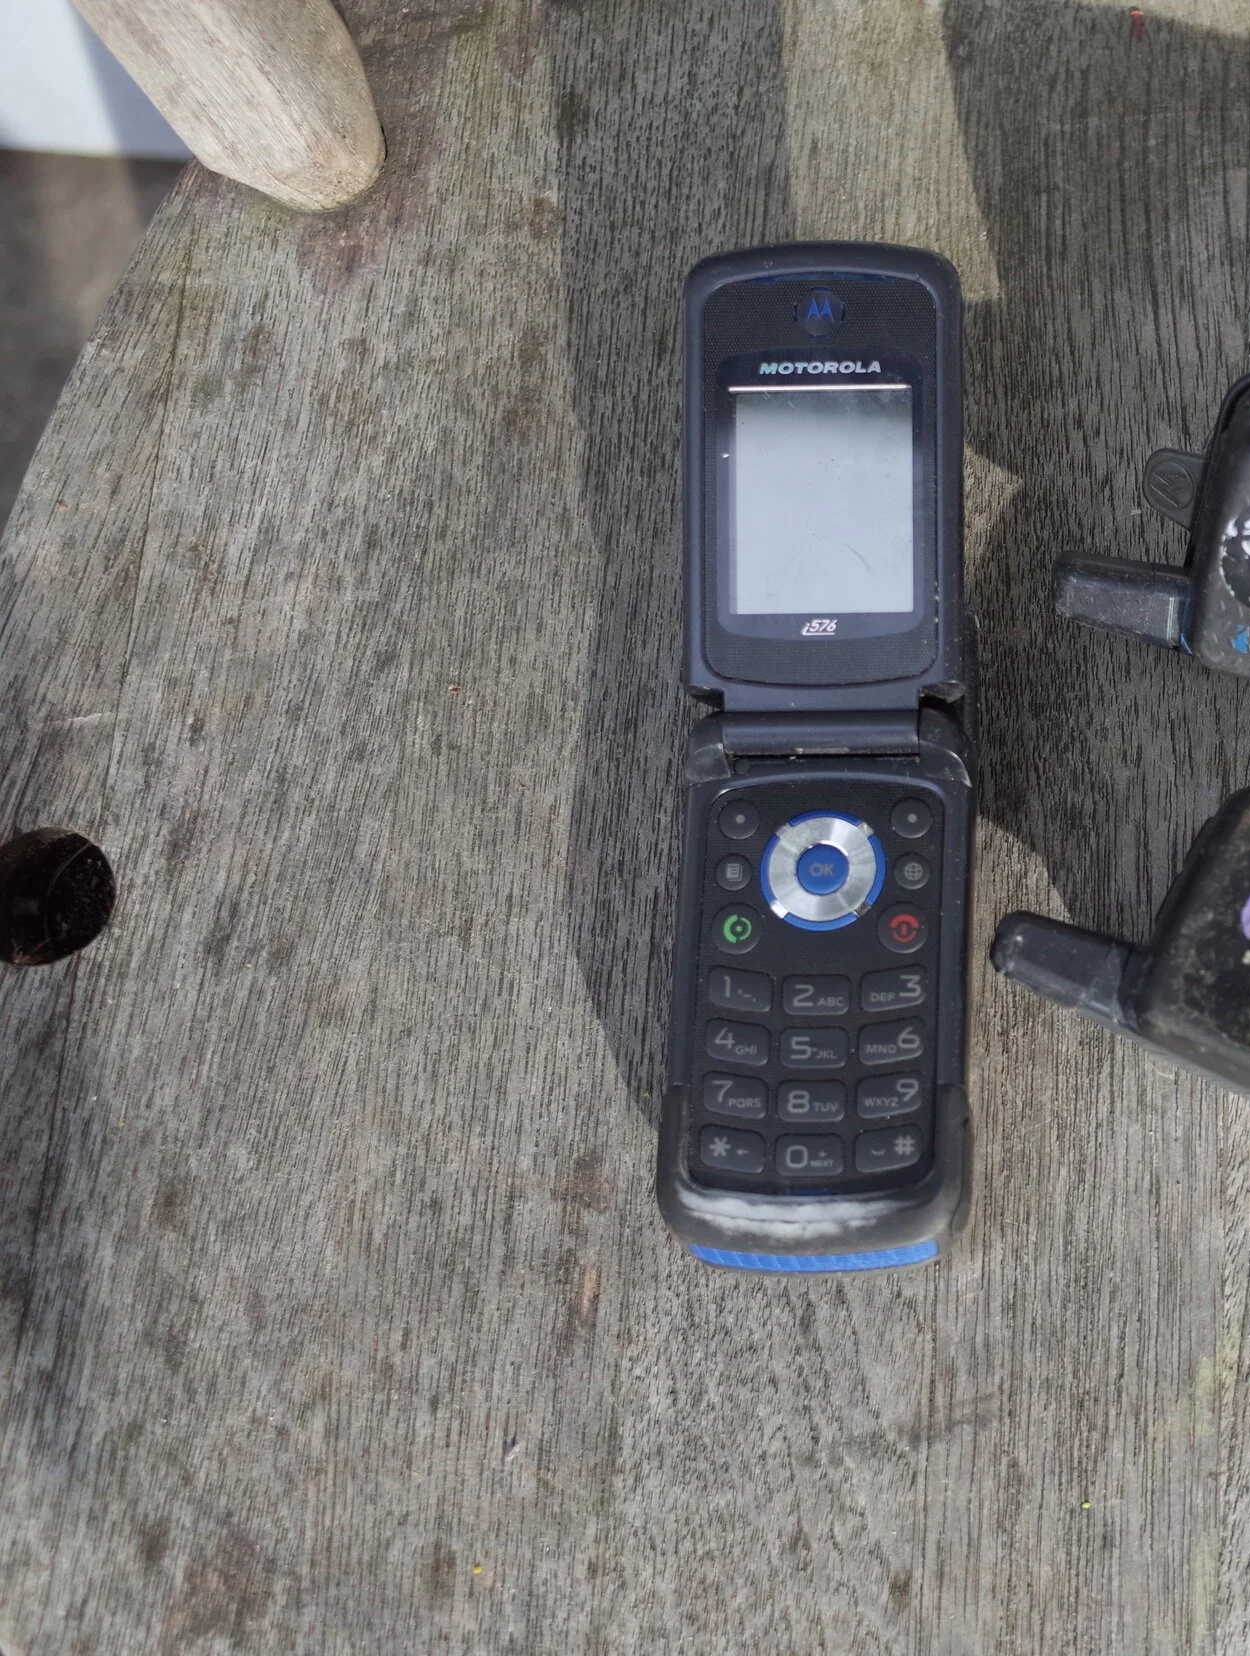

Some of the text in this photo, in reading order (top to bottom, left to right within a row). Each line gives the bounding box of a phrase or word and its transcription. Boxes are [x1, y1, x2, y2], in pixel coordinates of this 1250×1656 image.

[758, 361, 882, 375] MOTOROLA
[802, 618, 837, 635] i576
[809, 863, 835, 876] OK
[724, 976, 731, 998] 1
[793, 984, 844, 1007] 2 ABC
[870, 975, 921, 1002] DEF 3
[714, 1027, 757, 1055] 4 GHI
[791, 1037, 838, 1059] 5 JKL
[897, 1026, 920, 1049] 6
[712, 1080, 733, 1103] 7
[896, 1079, 919, 1101] 9
[788, 1091, 839, 1113] 8 TUV
